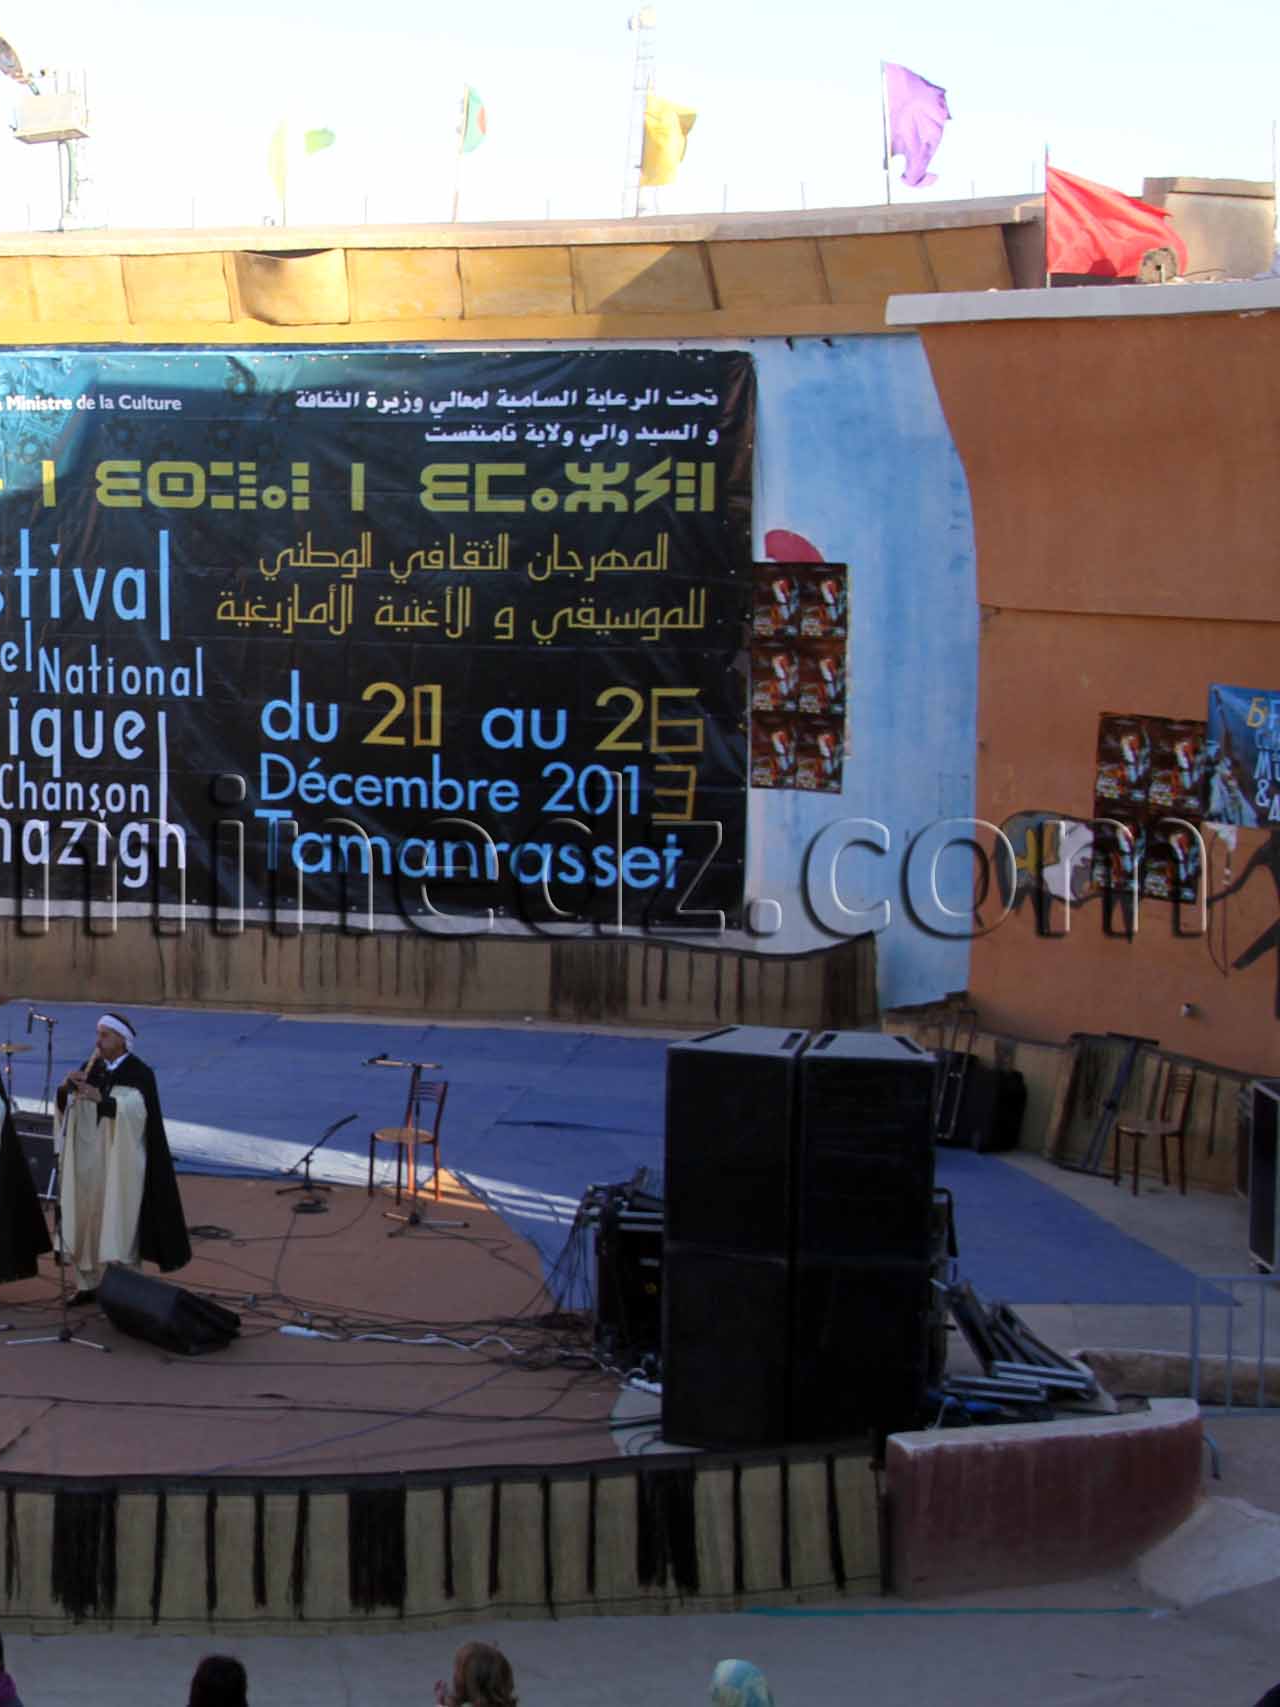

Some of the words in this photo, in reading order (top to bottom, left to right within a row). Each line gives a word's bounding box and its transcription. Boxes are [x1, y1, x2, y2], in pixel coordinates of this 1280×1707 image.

[7, 394, 72, 411] Ministre
[76, 393, 96, 410] de
[100, 393, 115, 410] la
[119, 393, 183, 411] Culture
[295, 389, 360, 409] الثقافة
[585, 387, 660, 412] الرعاية
[666, 387, 719, 406] تحت
[635, 423, 699, 447] السيد
[259, 530, 372, 581] الوطني
[389, 532, 509, 584] الثقافي
[528, 532, 669, 582] المهرجان
[374, 585, 472, 638] الأغنية
[38, 647, 204, 698] National
[260, 670, 340, 744] du
[481, 705, 568, 750] au
[260, 752, 520, 813] Décembre
[255, 809, 683, 889] Tamanrasset
